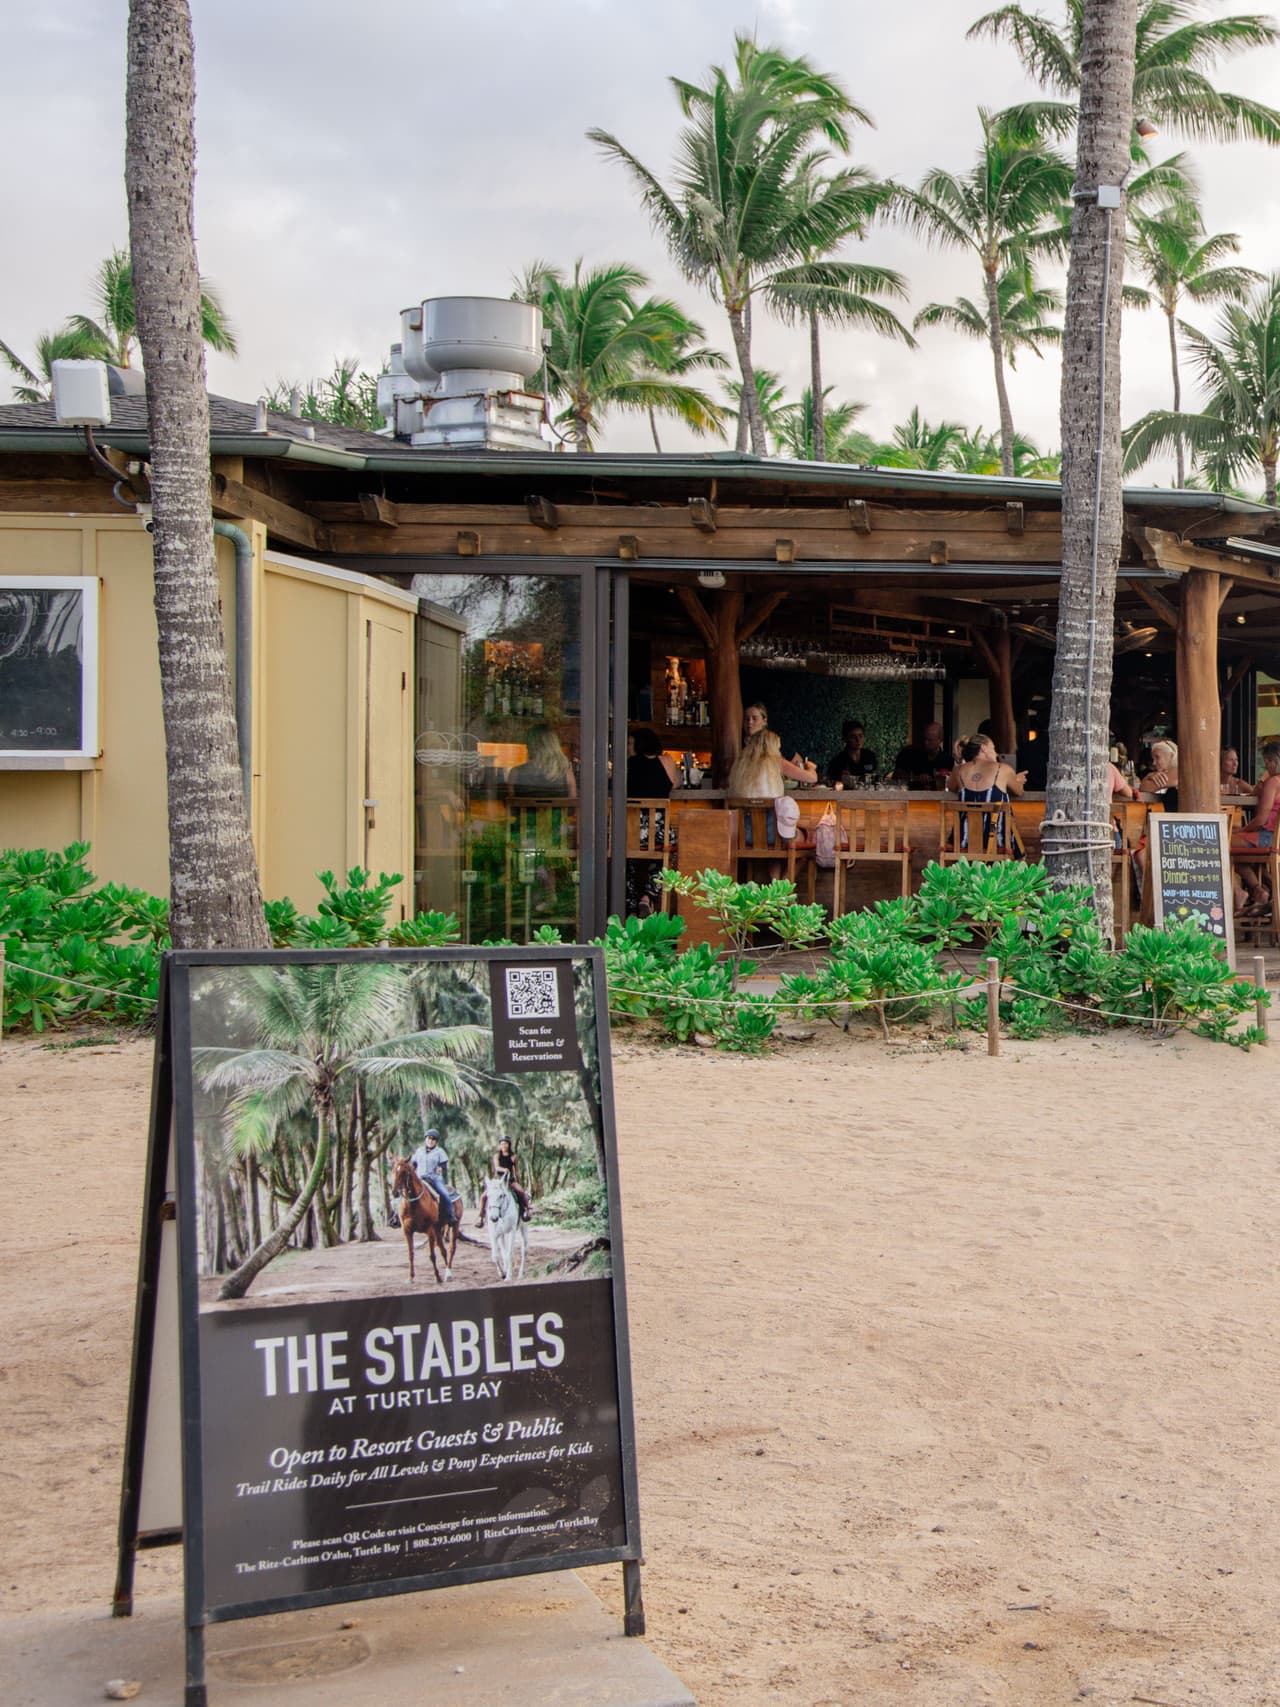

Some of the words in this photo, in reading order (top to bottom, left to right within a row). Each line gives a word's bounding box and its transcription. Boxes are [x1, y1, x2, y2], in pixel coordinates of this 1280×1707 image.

[1162, 824, 1170, 838] E
[508, 1040, 528, 1048] Ride
[528, 1039, 554, 1047] Times
[556, 1038, 565, 1047] &
[519, 1026, 539, 1035] Scan
[540, 1025, 552, 1034] for
[512, 1052, 562, 1062] Reservations
[254, 1331, 350, 1397] THE
[365, 1312, 565, 1386] STABLES
[329, 1396, 357, 1415] AT
[366, 1386, 453, 1411] TURTLE
[462, 1380, 502, 1401] BAY
[269, 1447, 325, 1475] Open
[329, 1444, 347, 1461] to
[350, 1436, 413, 1459] Resort
[417, 1429, 478, 1451] Guests
[482, 1422, 504, 1443] &
[505, 1417, 564, 1441] Public
[236, 1480, 271, 1497] Trail
[272, 1478, 307, 1493] Rides
[310, 1471, 347, 1489] Daily
[345, 1469, 367, 1488] for
[368, 1464, 388, 1481] All
[390, 1461, 428, 1477] Levels
[431, 1459, 445, 1473] &
[448, 1456, 478, 1473] Pony
[479, 1449, 546, 1469] Experiences
[545, 1446, 565, 1463] for
[567, 1441, 593, 1457] Kids
[235, 1563, 257, 1574] The
[258, 1553, 320, 1571] Ritz-Carlton
[353, 1545, 382, 1557] Turtle
[383, 1542, 400, 1554] Bay
[413, 1532, 472, 1549] 808.293.6000
[483, 1516, 600, 1540] RitzCarlton.com/TurtleBay
[291, 1539, 321, 1550] Please
[322, 1537, 342, 1546] scan
[343, 1532, 361, 1545] QR
[362, 1529, 386, 1541] Code
[387, 1529, 397, 1537] or
[398, 1525, 416, 1536] visit
[417, 1520, 460, 1533] Concierge
[461, 1518, 474, 1528] for
[475, 1516, 496, 1525] more
[498, 1509, 549, 1522] information.
